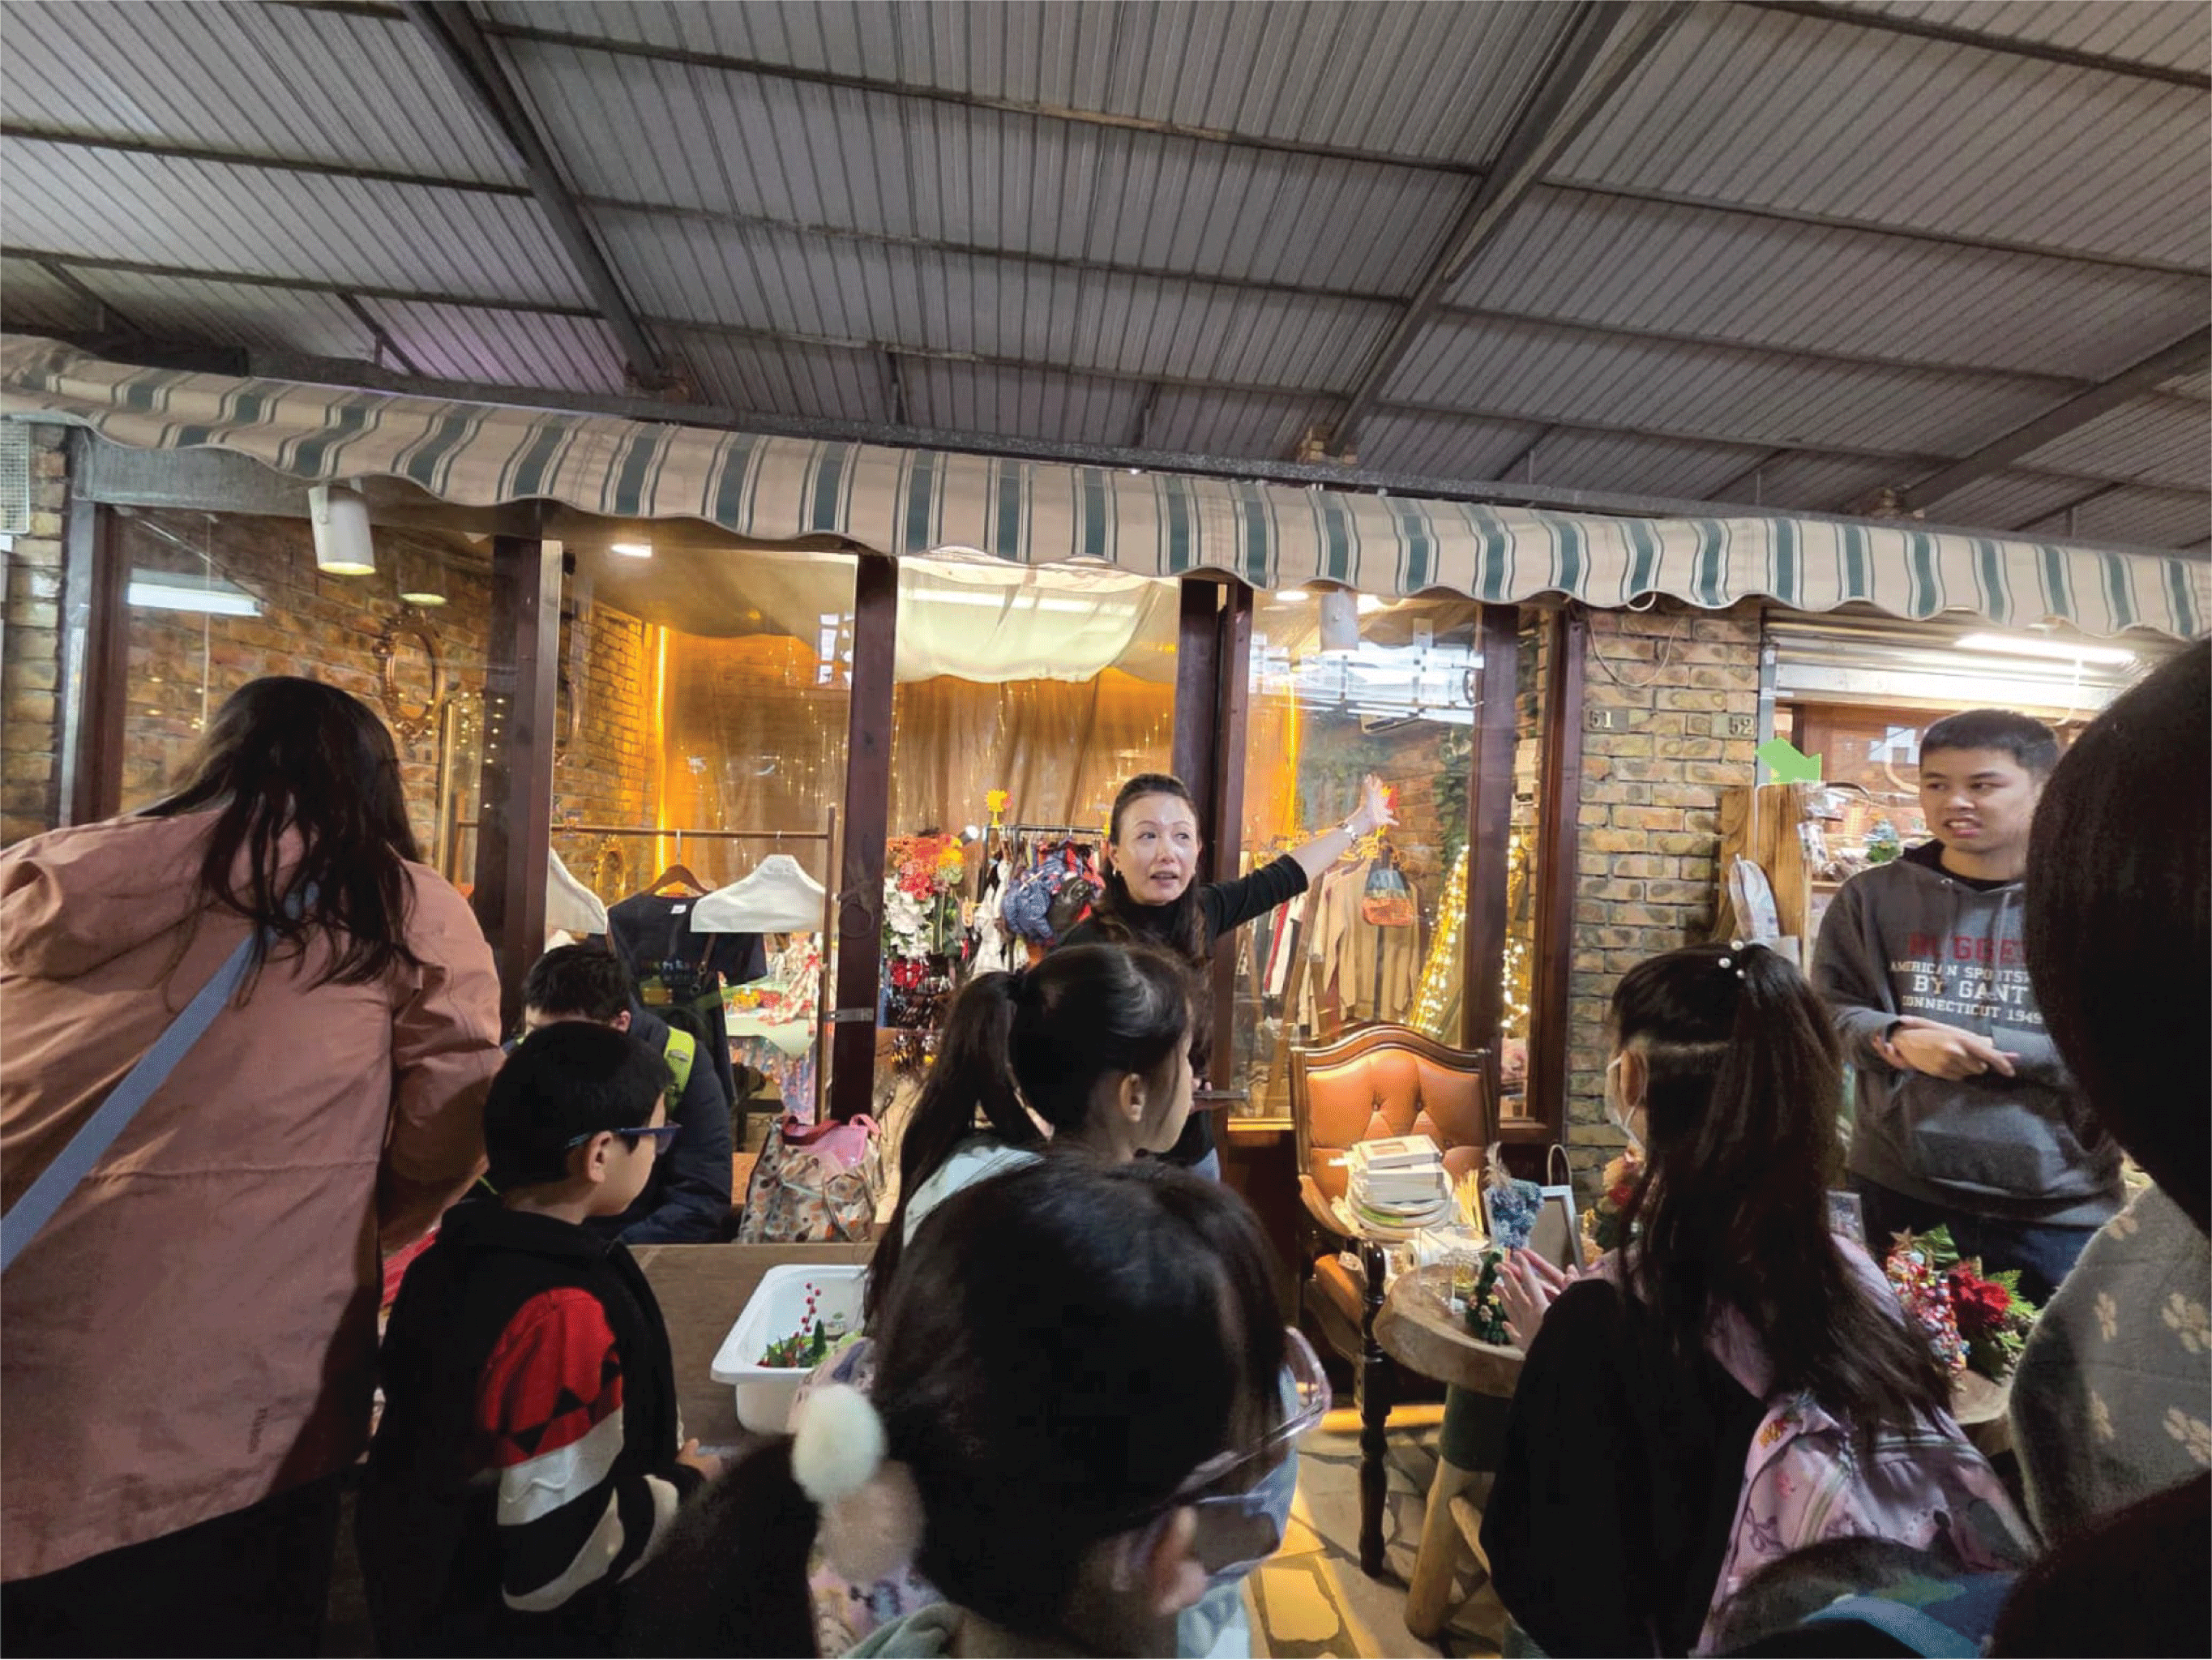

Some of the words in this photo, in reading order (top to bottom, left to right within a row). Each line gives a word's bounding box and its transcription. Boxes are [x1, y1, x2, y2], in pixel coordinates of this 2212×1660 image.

[1589, 710, 1614, 729] 51
[1727, 716, 1755, 735] 52
[1913, 974, 1945, 995] BY
[1959, 980, 2029, 1004] GANT
[2007, 1008, 2043, 1024] 1949
